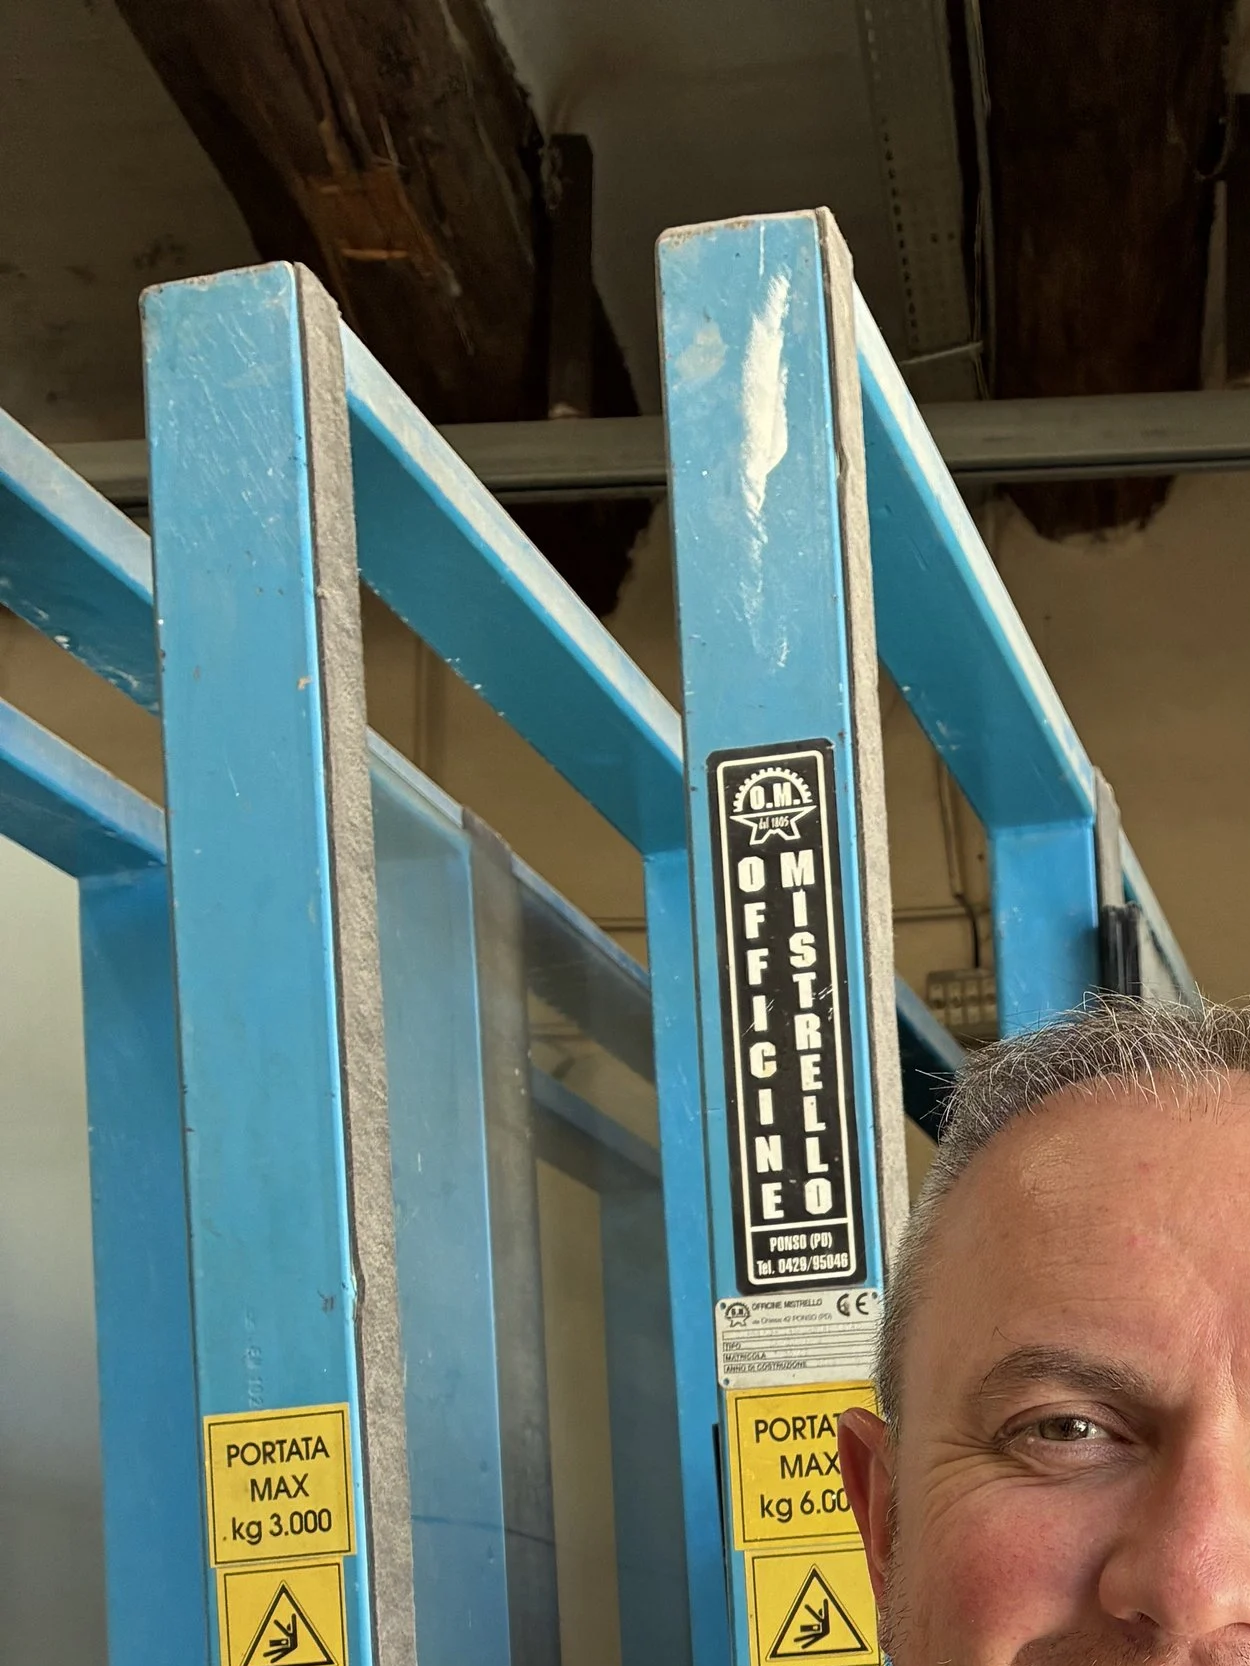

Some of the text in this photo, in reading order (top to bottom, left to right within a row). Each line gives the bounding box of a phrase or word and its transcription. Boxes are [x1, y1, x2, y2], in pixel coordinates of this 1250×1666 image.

[749, 782, 801, 811] O.M.
[738, 855, 784, 1220] OFFICINE
[780, 849, 833, 1216] MISTRELLO
[769, 1231, 833, 1253] PONSO (PD)
[756, 1260, 776, 1276] Tel.
[226, 1435, 331, 1468] PORTATA
[780, 1451, 841, 1480] MAX
[250, 1473, 310, 1503] MAX
[760, 1493, 793, 1523] kg
[231, 1508, 332, 1546] kg 3.000
